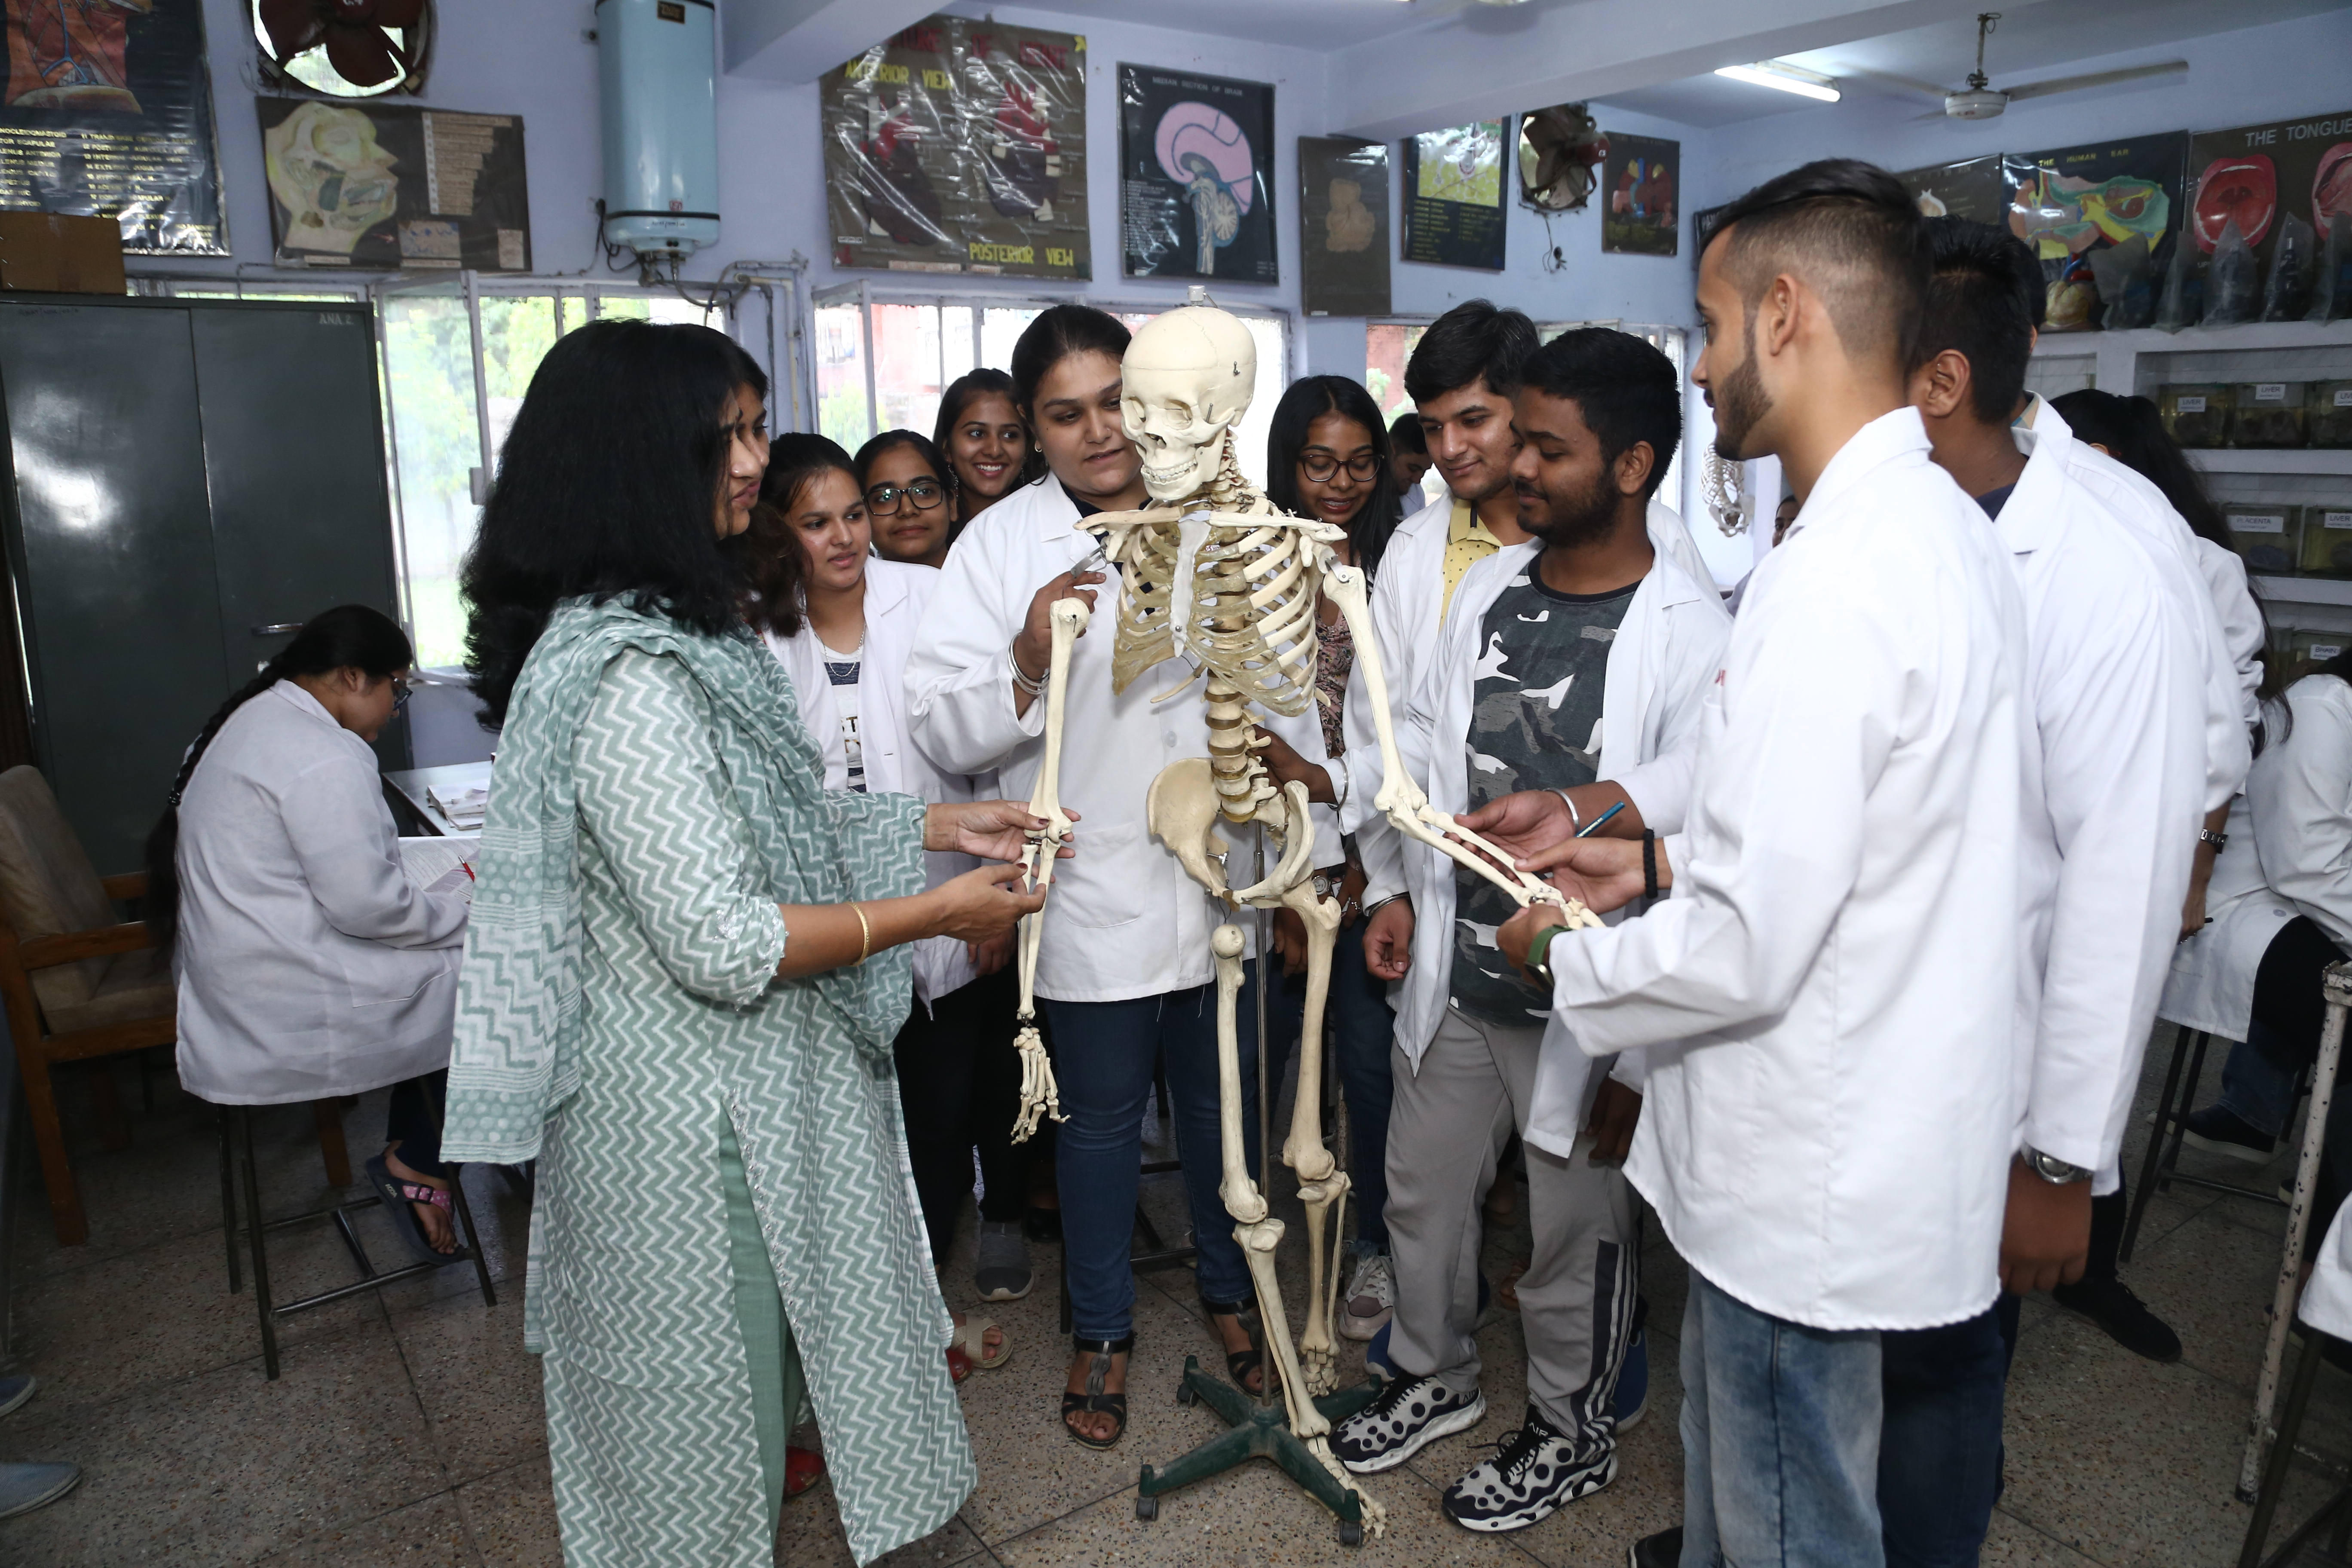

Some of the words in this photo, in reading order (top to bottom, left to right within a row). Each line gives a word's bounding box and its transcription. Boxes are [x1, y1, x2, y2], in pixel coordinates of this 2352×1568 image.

[844, 61, 909, 84] ANTERIOR
[2245, 129, 2277, 147] THE
[2286, 118, 2352, 141] TONGUE
[2038, 158, 2055, 167] THE
[2067, 153, 2097, 163] HUMAN
[2111, 149, 2128, 157] EAR
[970, 242, 1033, 264] POSTERIOR
[1045, 247, 1073, 266] VIEW
